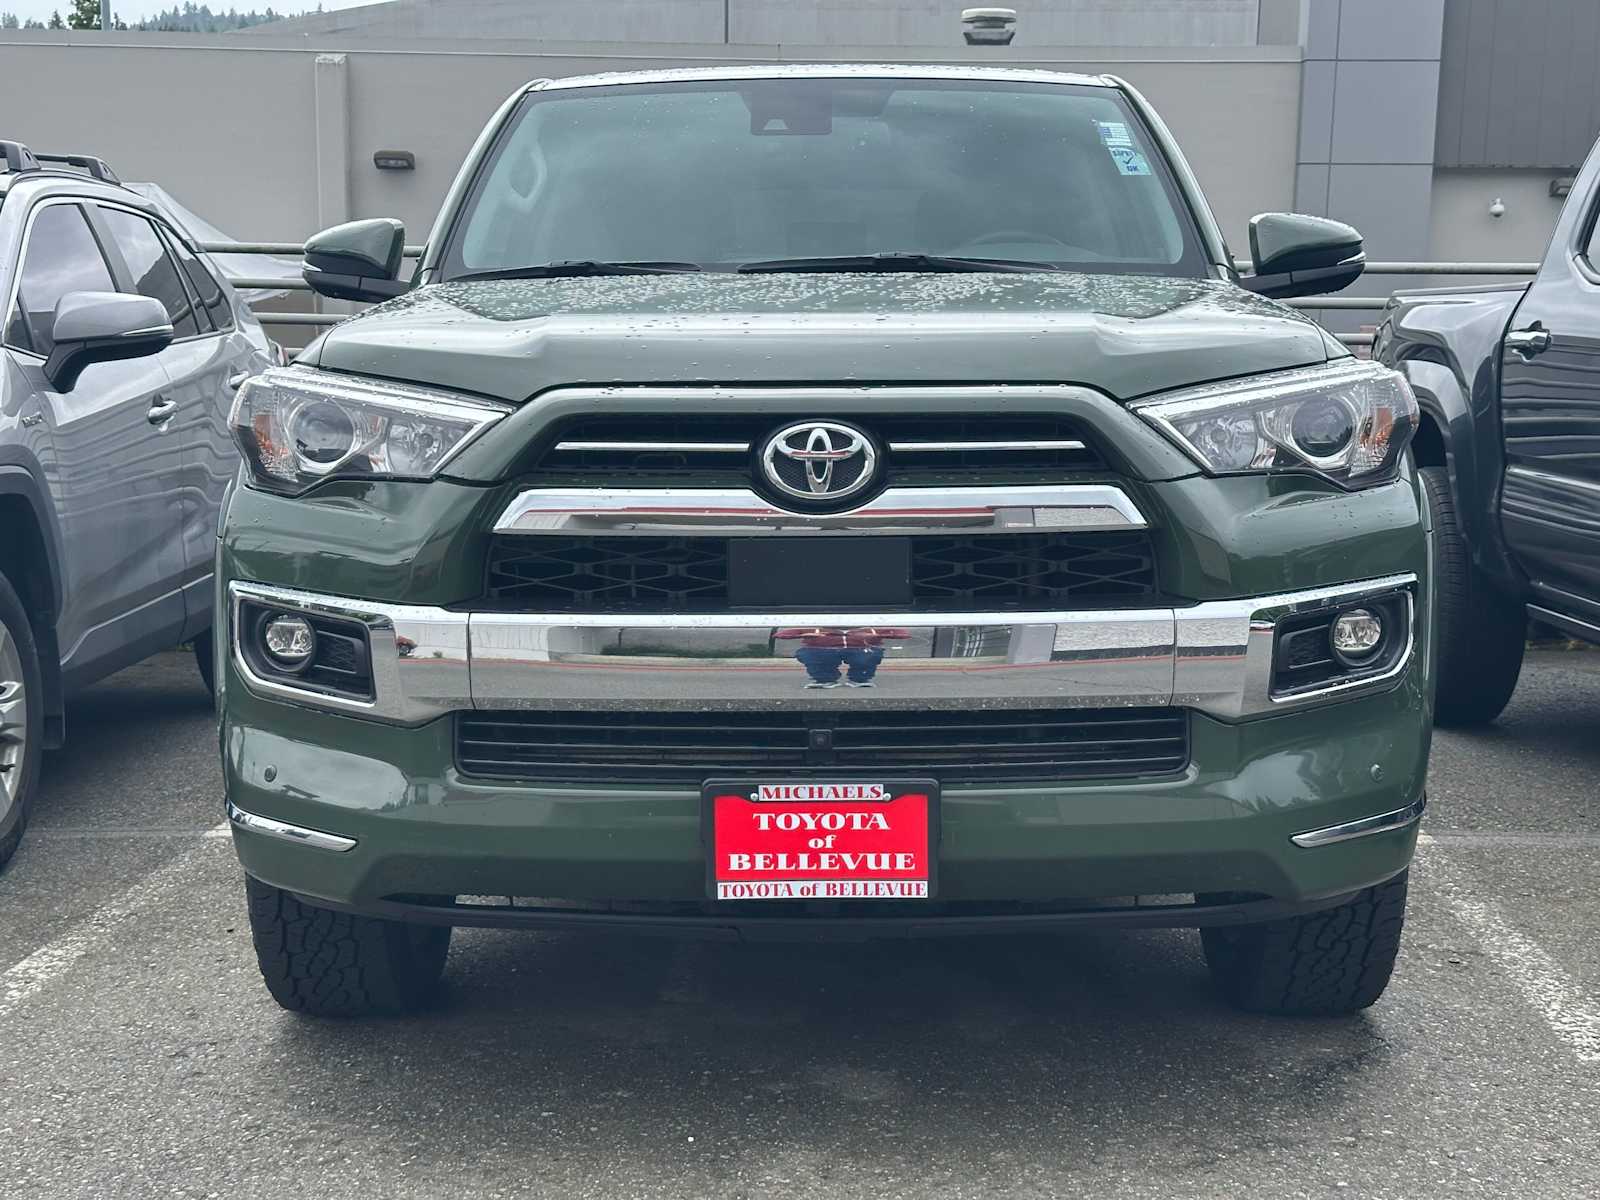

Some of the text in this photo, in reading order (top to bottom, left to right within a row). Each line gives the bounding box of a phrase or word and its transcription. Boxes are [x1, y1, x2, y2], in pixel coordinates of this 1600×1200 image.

[762, 785, 882, 800] MICHAELS
[752, 812, 891, 831] TOYOTA
[808, 834, 837, 849] of
[728, 852, 916, 871] BELLEVUE
[719, 882, 926, 898] TOYOTA of BELLEVUE
